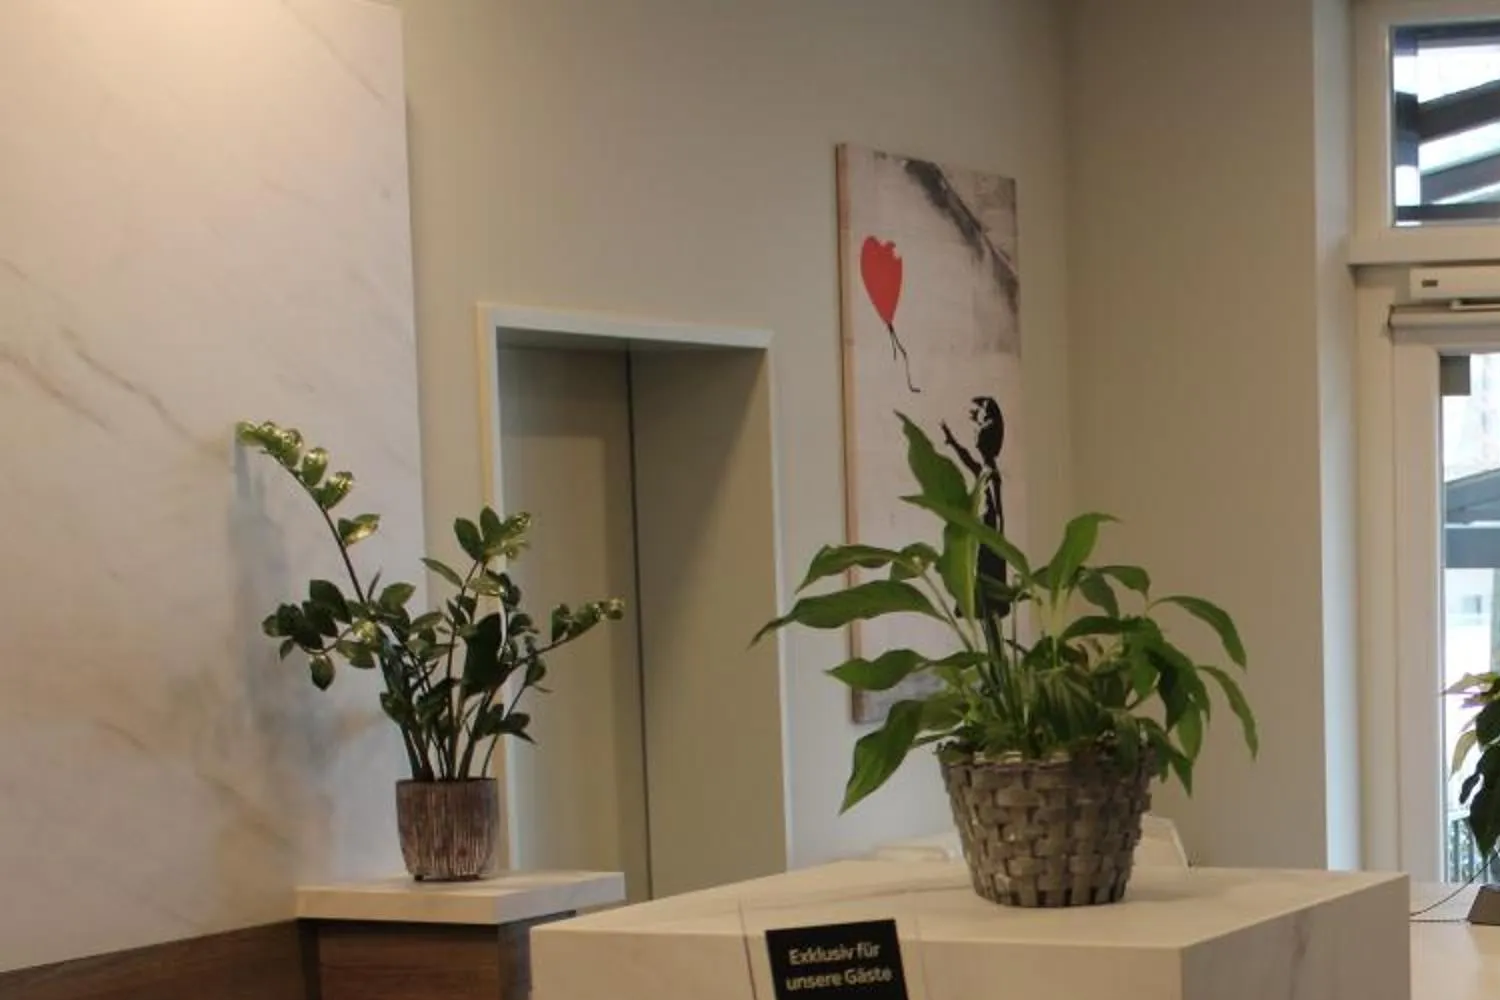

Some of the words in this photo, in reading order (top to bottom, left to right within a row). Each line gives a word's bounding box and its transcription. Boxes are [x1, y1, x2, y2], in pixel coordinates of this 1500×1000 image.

[788, 945, 855, 965] Exklusiv
[856, 941, 882, 960] für
[786, 972, 842, 991] unsere
[844, 967, 893, 986] Gäste
